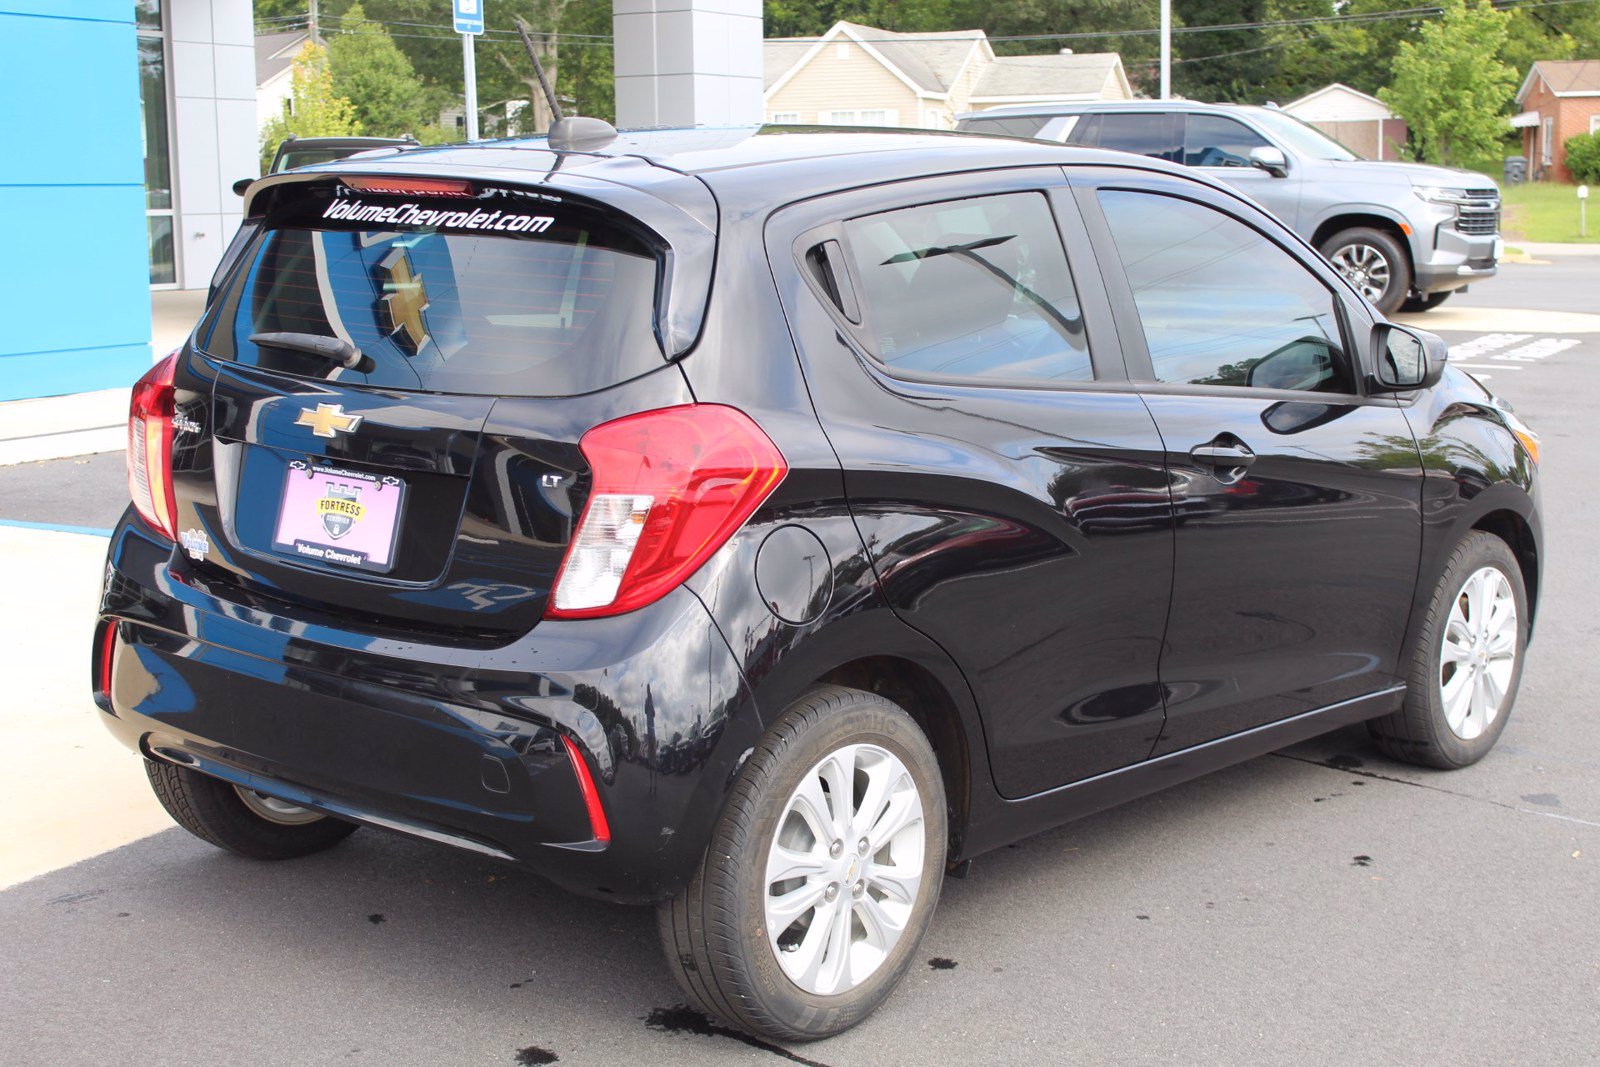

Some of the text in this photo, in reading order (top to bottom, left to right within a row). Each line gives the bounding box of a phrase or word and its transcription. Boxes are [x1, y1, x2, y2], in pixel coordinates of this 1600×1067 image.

[322, 198, 555, 233] VolumeChevrolet.com
[312, 466, 376, 480] www.VolumeChevrolet.com
[541, 474, 562, 488] LT
[320, 500, 361, 516] FORTRESS
[297, 544, 362, 564] Volume Chevrolet
